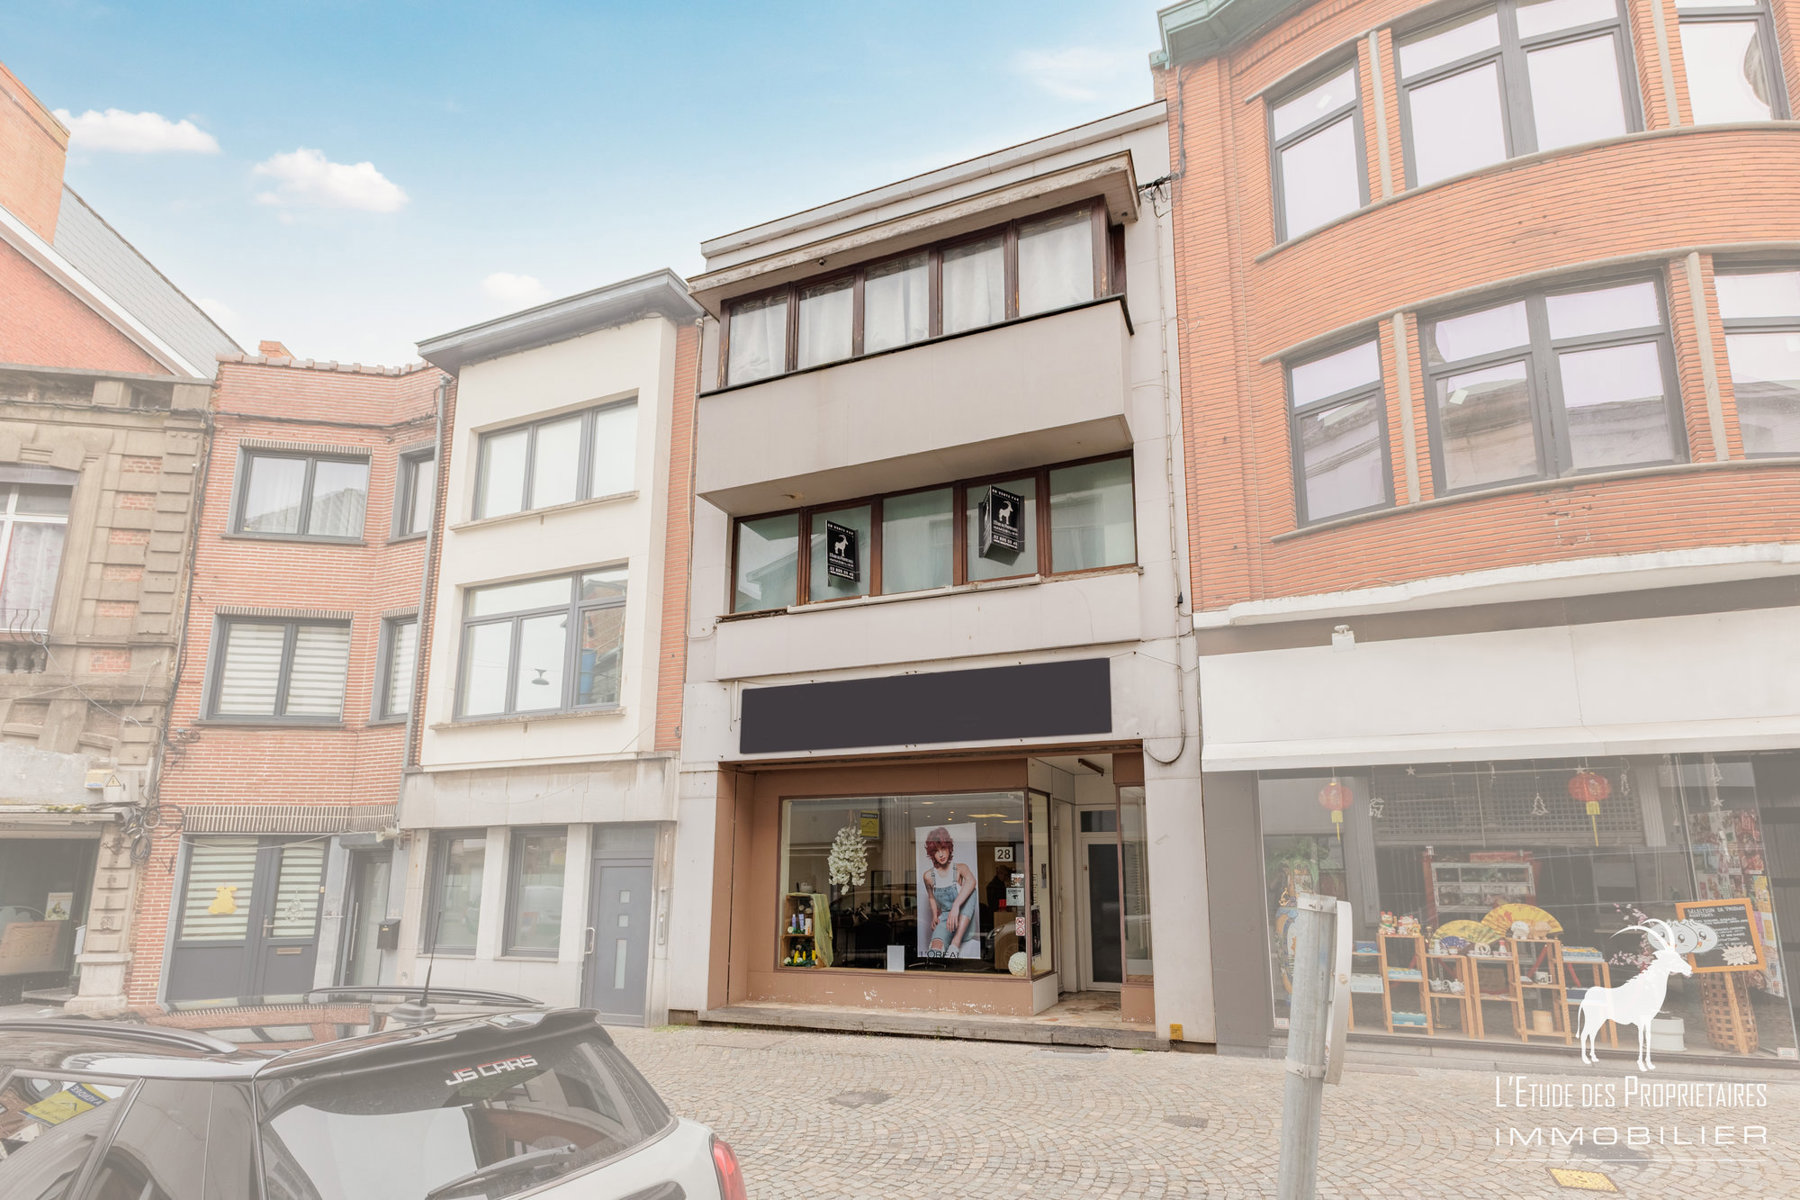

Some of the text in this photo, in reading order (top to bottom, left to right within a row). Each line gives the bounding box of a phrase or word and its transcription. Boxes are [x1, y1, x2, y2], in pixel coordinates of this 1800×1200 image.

[997, 849, 1011, 859] 28
[445, 1054, 539, 1086] JS CARS
